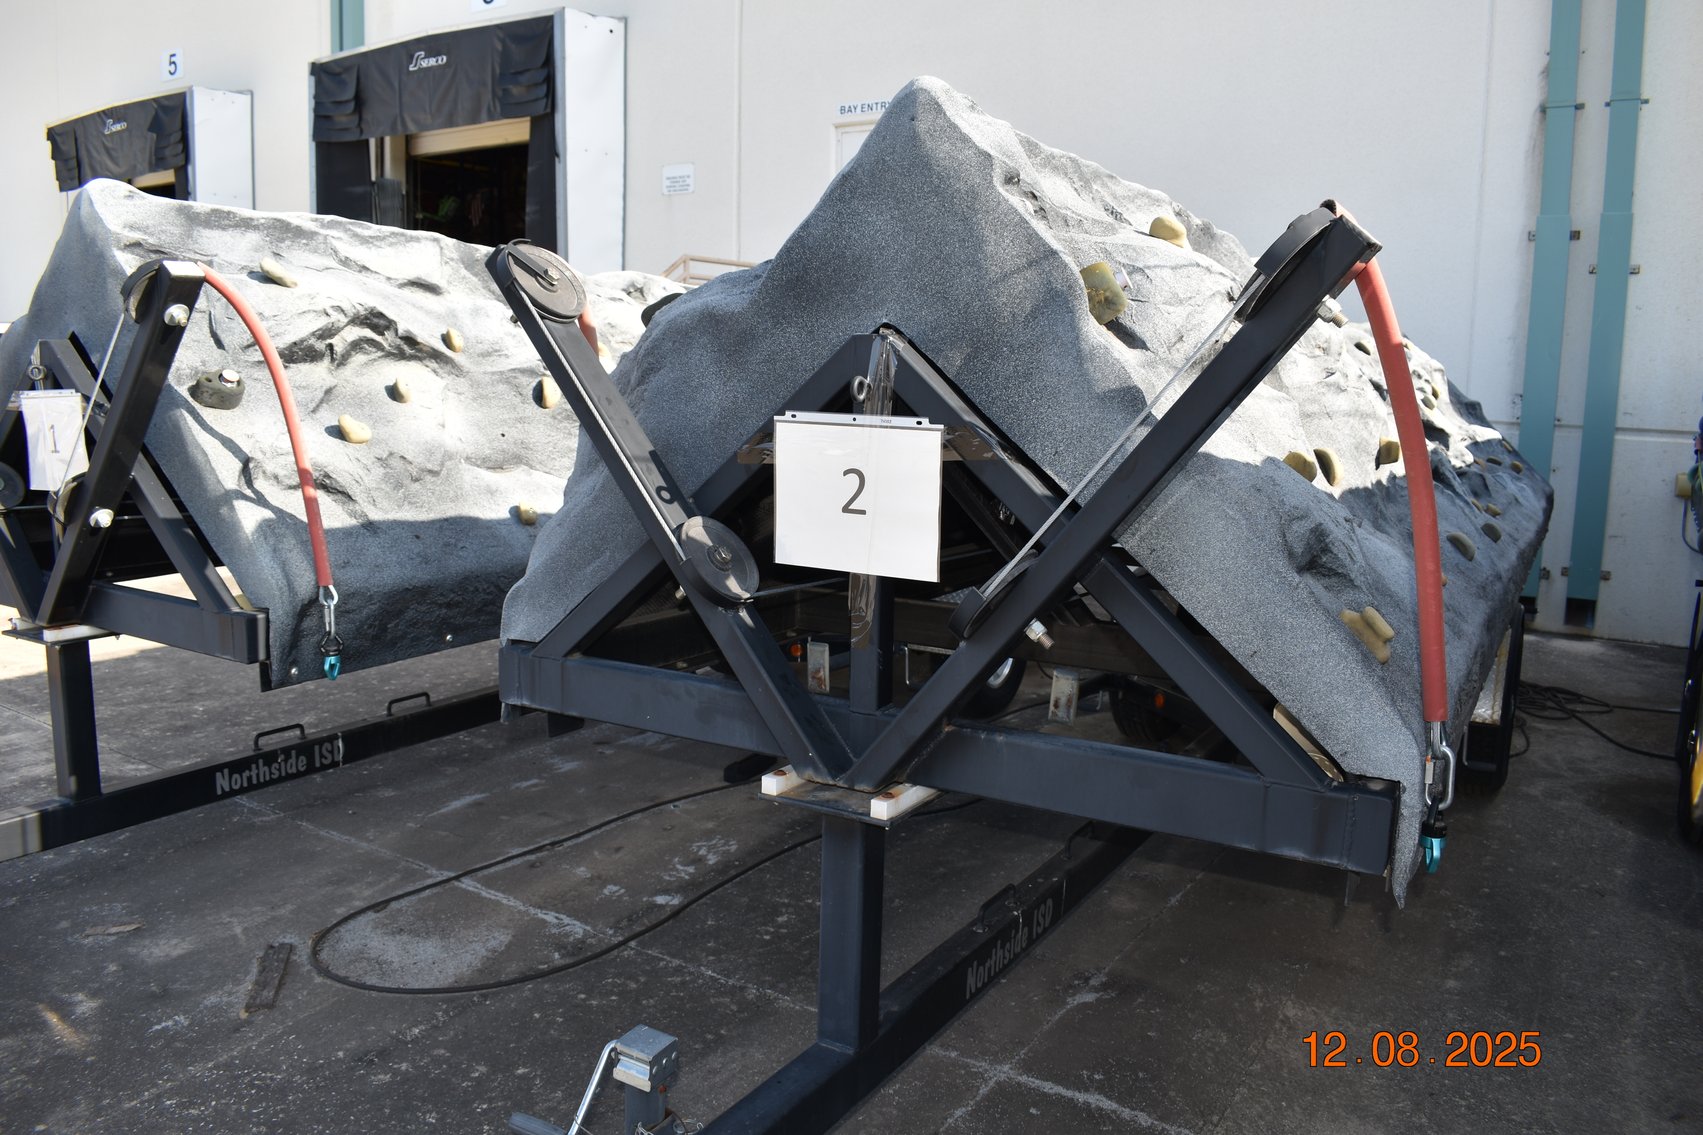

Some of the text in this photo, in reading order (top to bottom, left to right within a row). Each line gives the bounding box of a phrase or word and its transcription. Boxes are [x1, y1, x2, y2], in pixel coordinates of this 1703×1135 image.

[168, 54, 178, 75] 5
[840, 105, 858, 115] BAY
[50, 424, 60, 453] 1
[841, 467, 867, 515] 2
[215, 739, 345, 795] Northside ISD
[965, 898, 1053, 999] Northside ISD
